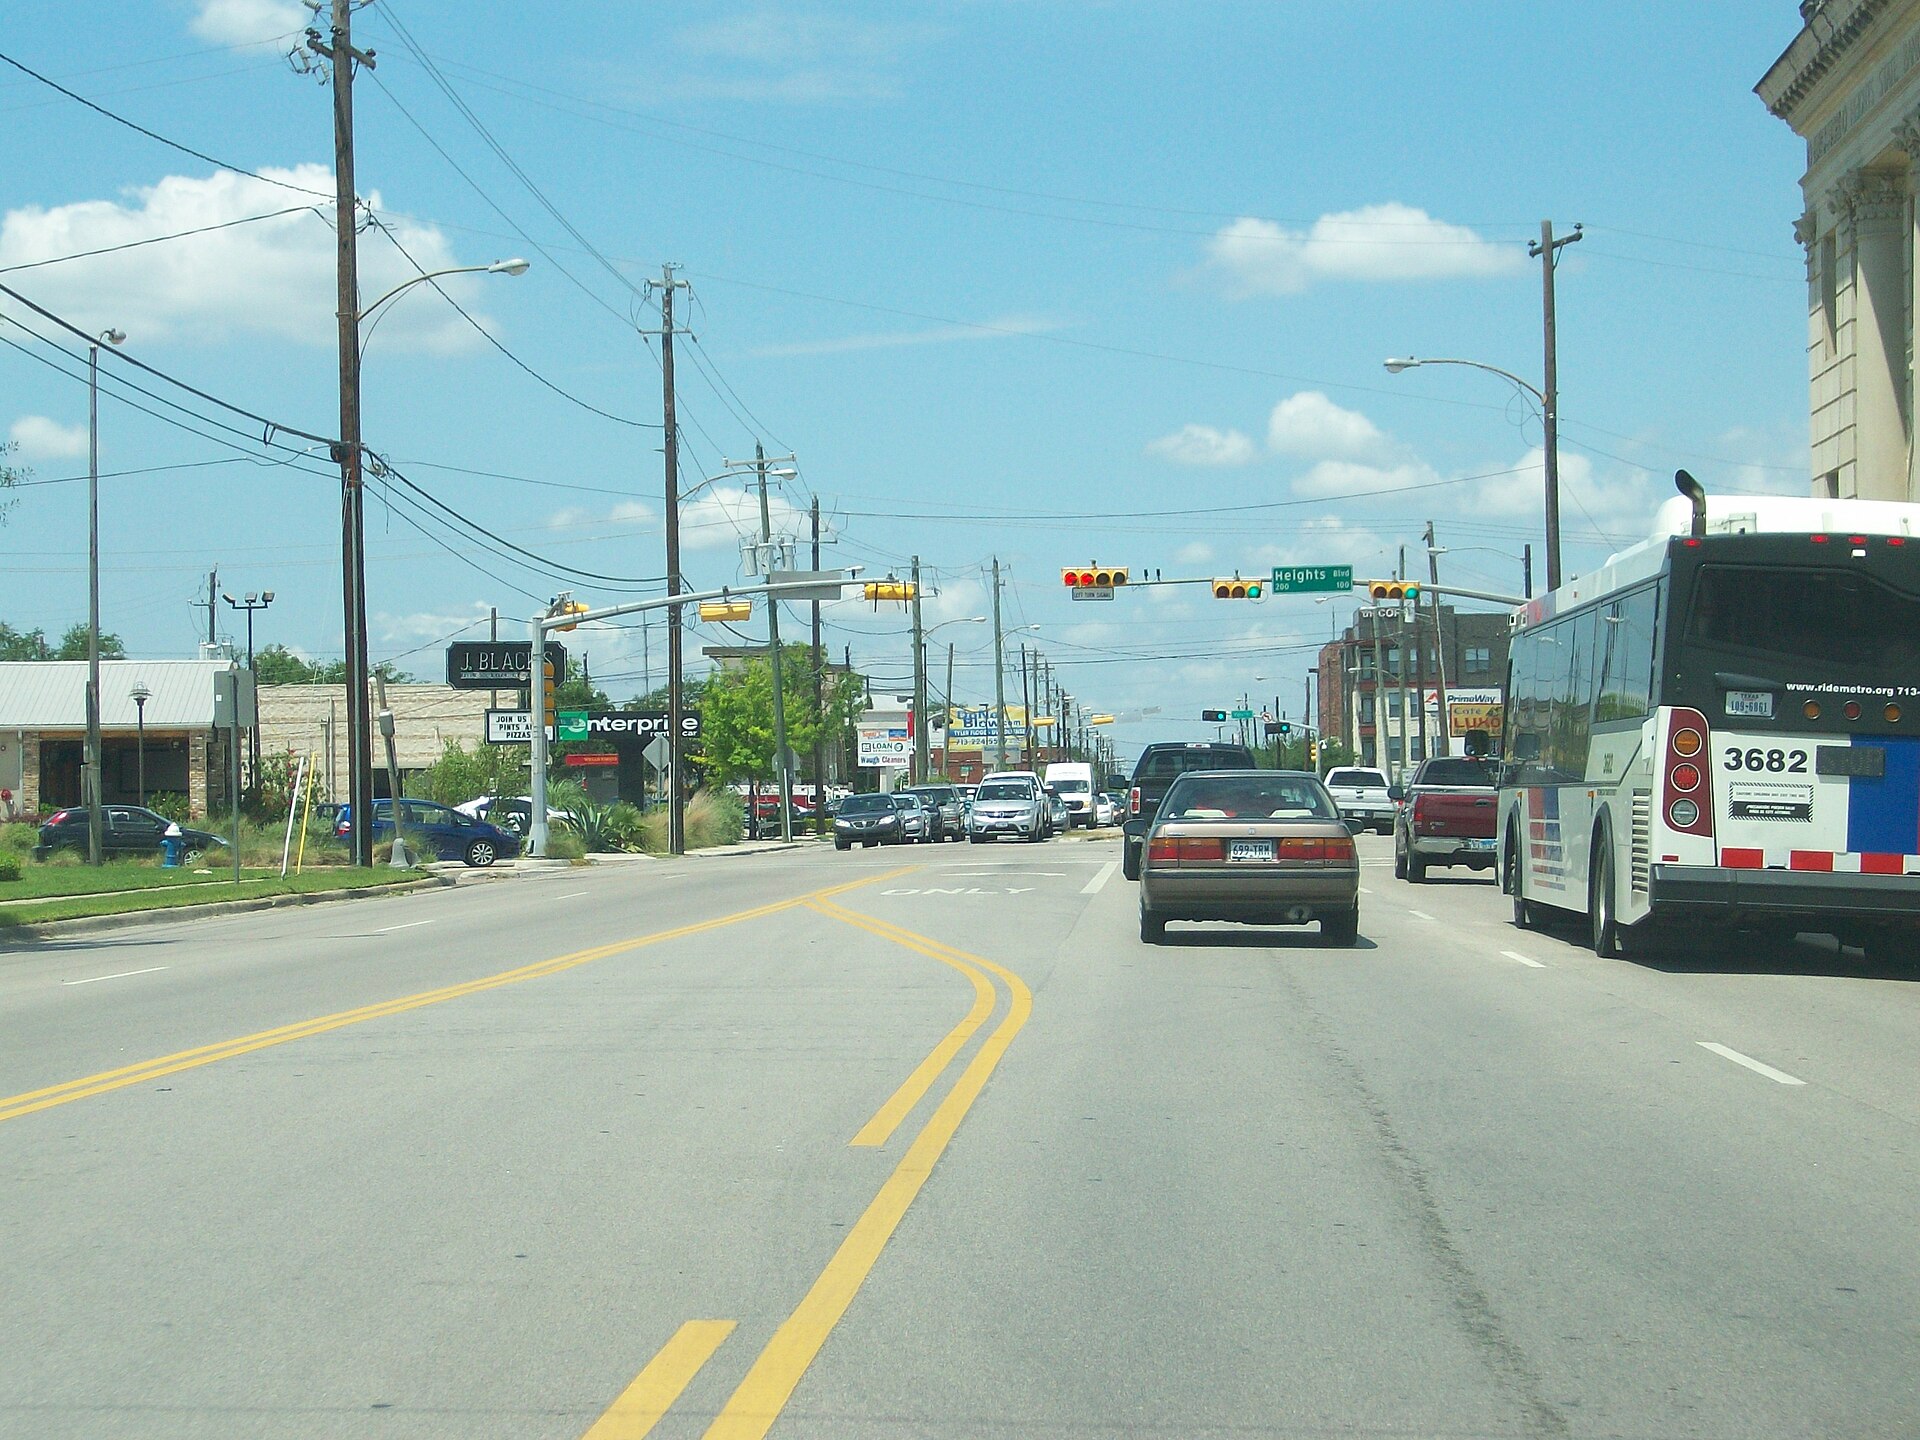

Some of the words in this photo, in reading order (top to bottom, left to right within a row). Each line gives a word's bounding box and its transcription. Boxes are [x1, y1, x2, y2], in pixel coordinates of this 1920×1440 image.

[1275, 568, 1326, 583] Heights
[1333, 569, 1350, 577] Blvd
[1275, 583, 1290, 591] 200
[1336, 581, 1350, 589] 100
[460, 652, 473, 671] J.
[1786, 683, 1894, 697] www.ridemetro.org
[1447, 694, 1496, 705] PrimeWay
[568, 714, 699, 735] enterprie
[861, 756, 880, 765] Waugh
[882, 756, 906, 764] Cleaners
[1723, 747, 1808, 773] 3682
[880, 887, 1037, 895] ONLY
